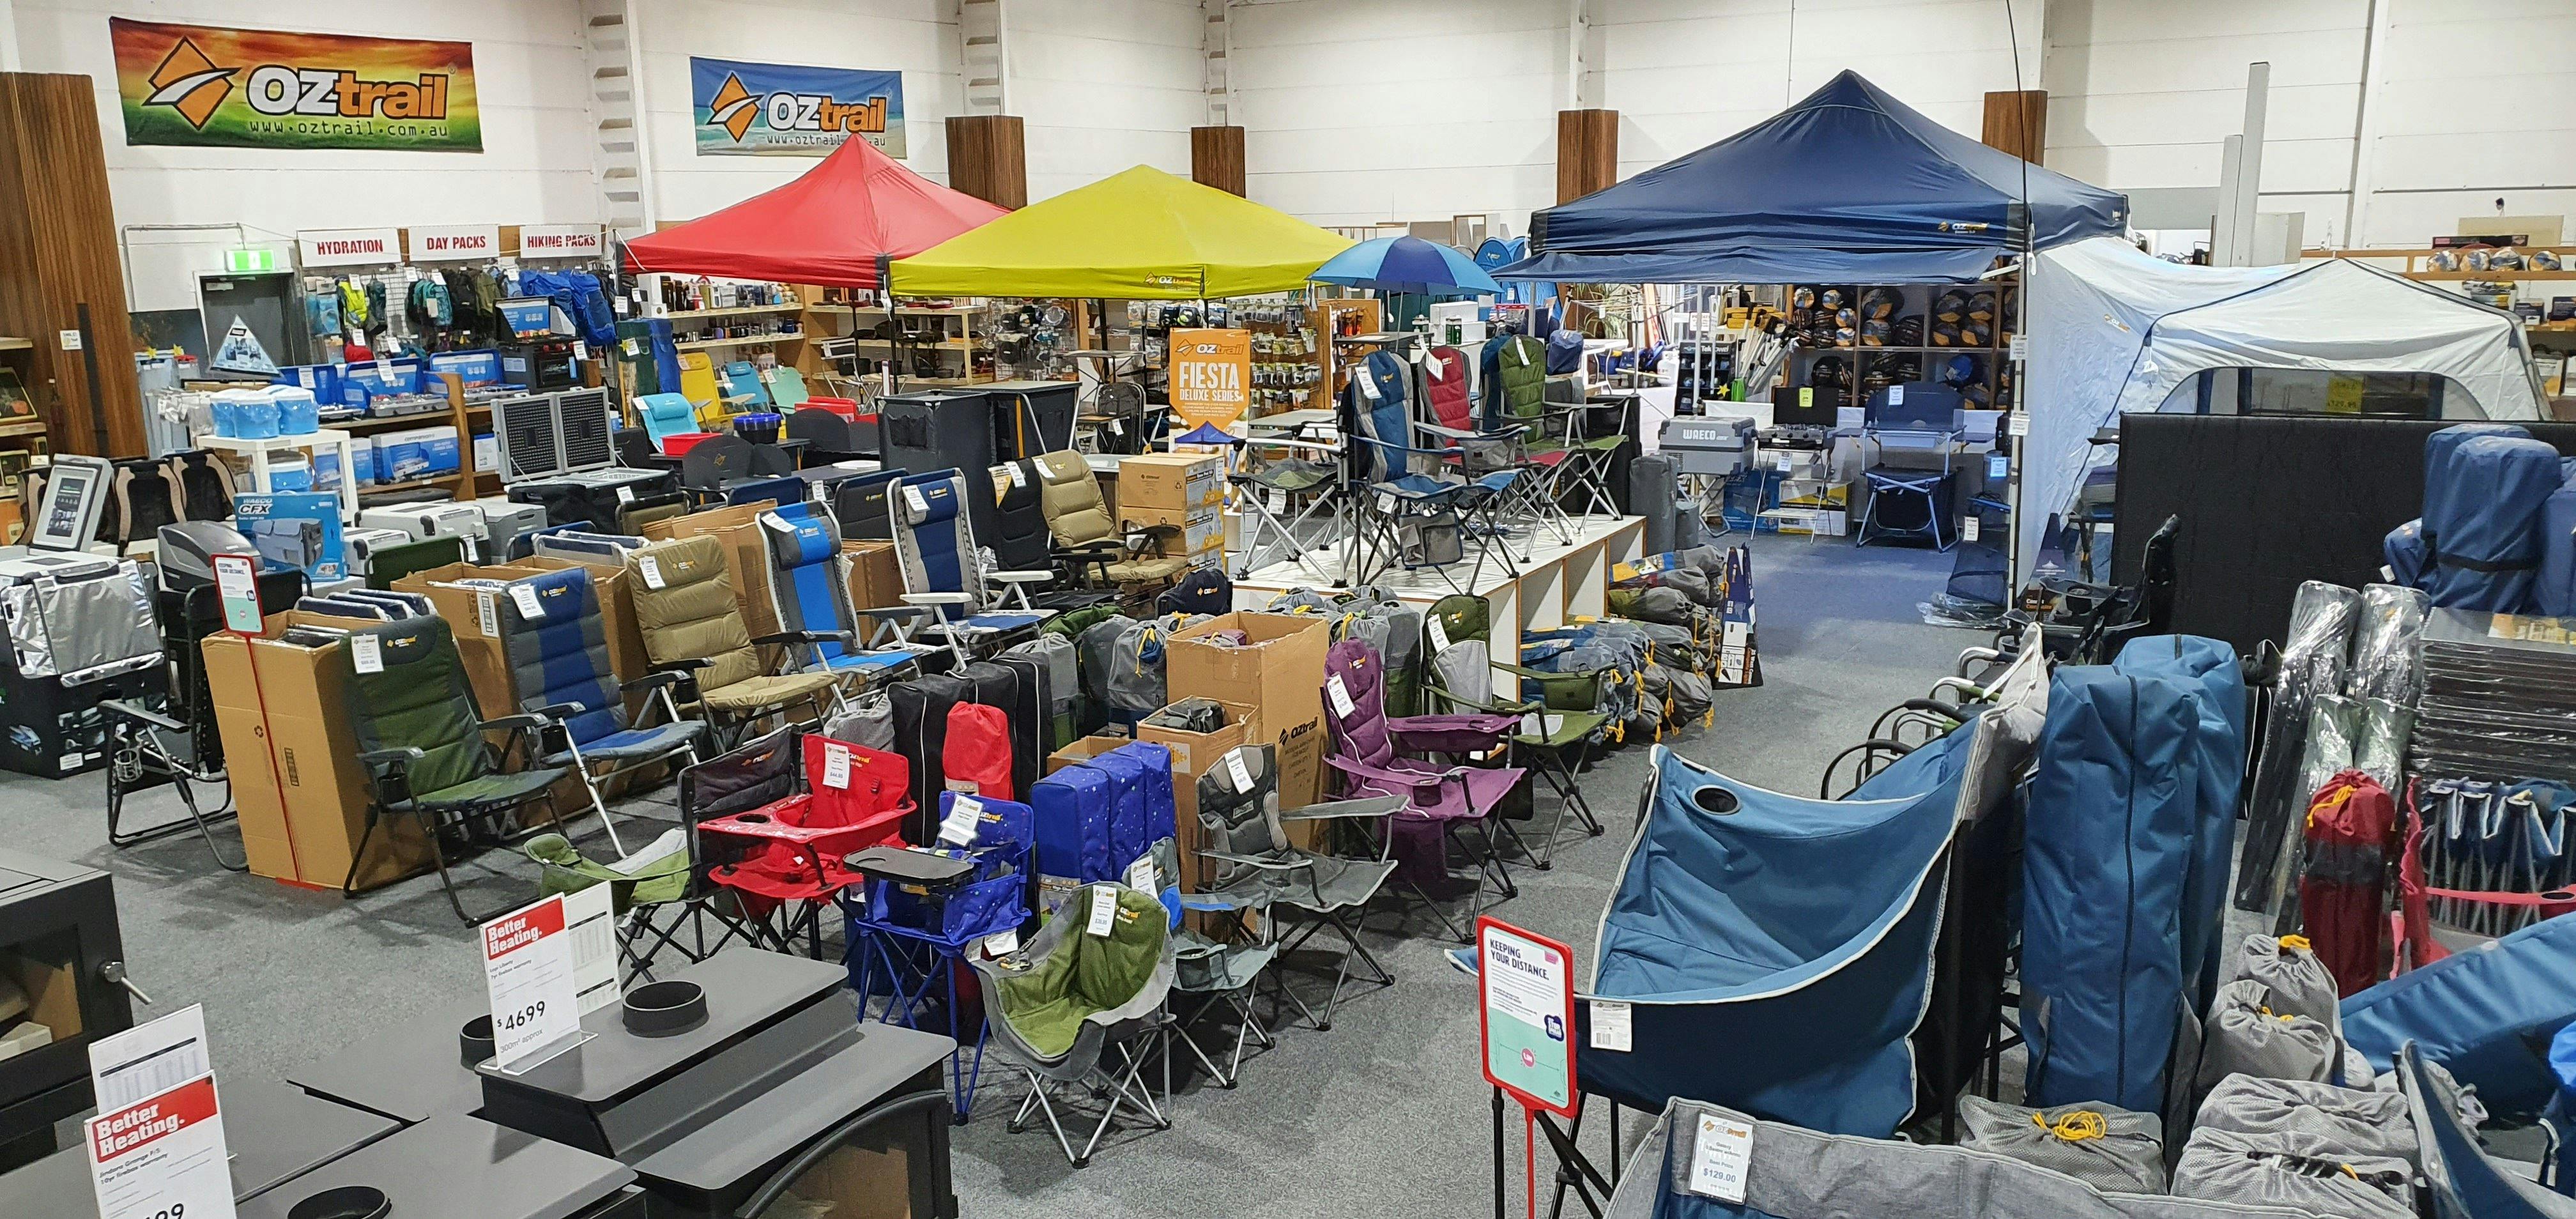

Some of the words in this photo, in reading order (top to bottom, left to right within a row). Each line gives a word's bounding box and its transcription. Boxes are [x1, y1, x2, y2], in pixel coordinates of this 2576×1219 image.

[246, 65, 448, 120] OZtrail
[767, 91, 887, 134] OZtrail
[250, 120, 448, 137] www.oztrail.com.au
[318, 239, 383, 256] HYDRATION
[426, 236, 449, 250] DAY
[452, 235, 486, 249] PACKS
[527, 235, 562, 248] HIKING
[565, 234, 596, 247] PACKS
[1195, 343, 1244, 355] OZtrail
[1179, 362, 1239, 389] FIESTA
[1179, 388, 1208, 401] DELUXE
[1211, 389, 1239, 402] SERIES
[1683, 429, 1716, 440] WAECO
[240, 504, 272, 514] CFX
[1291, 716, 1317, 739] OZtrail
[487, 916, 526, 942] Better
[490, 926, 542, 956] Heating.
[1489, 939, 1521, 959] KEEPING
[1491, 949, 1510, 965] YOUR
[1511, 958, 1549, 981] DISTANCE.
[523, 1029, 543, 1043] approx
[97, 1103, 159, 1140] Better
[98, 1114, 185, 1158] Heating.
[1703, 1167, 1736, 1183] $129.00
